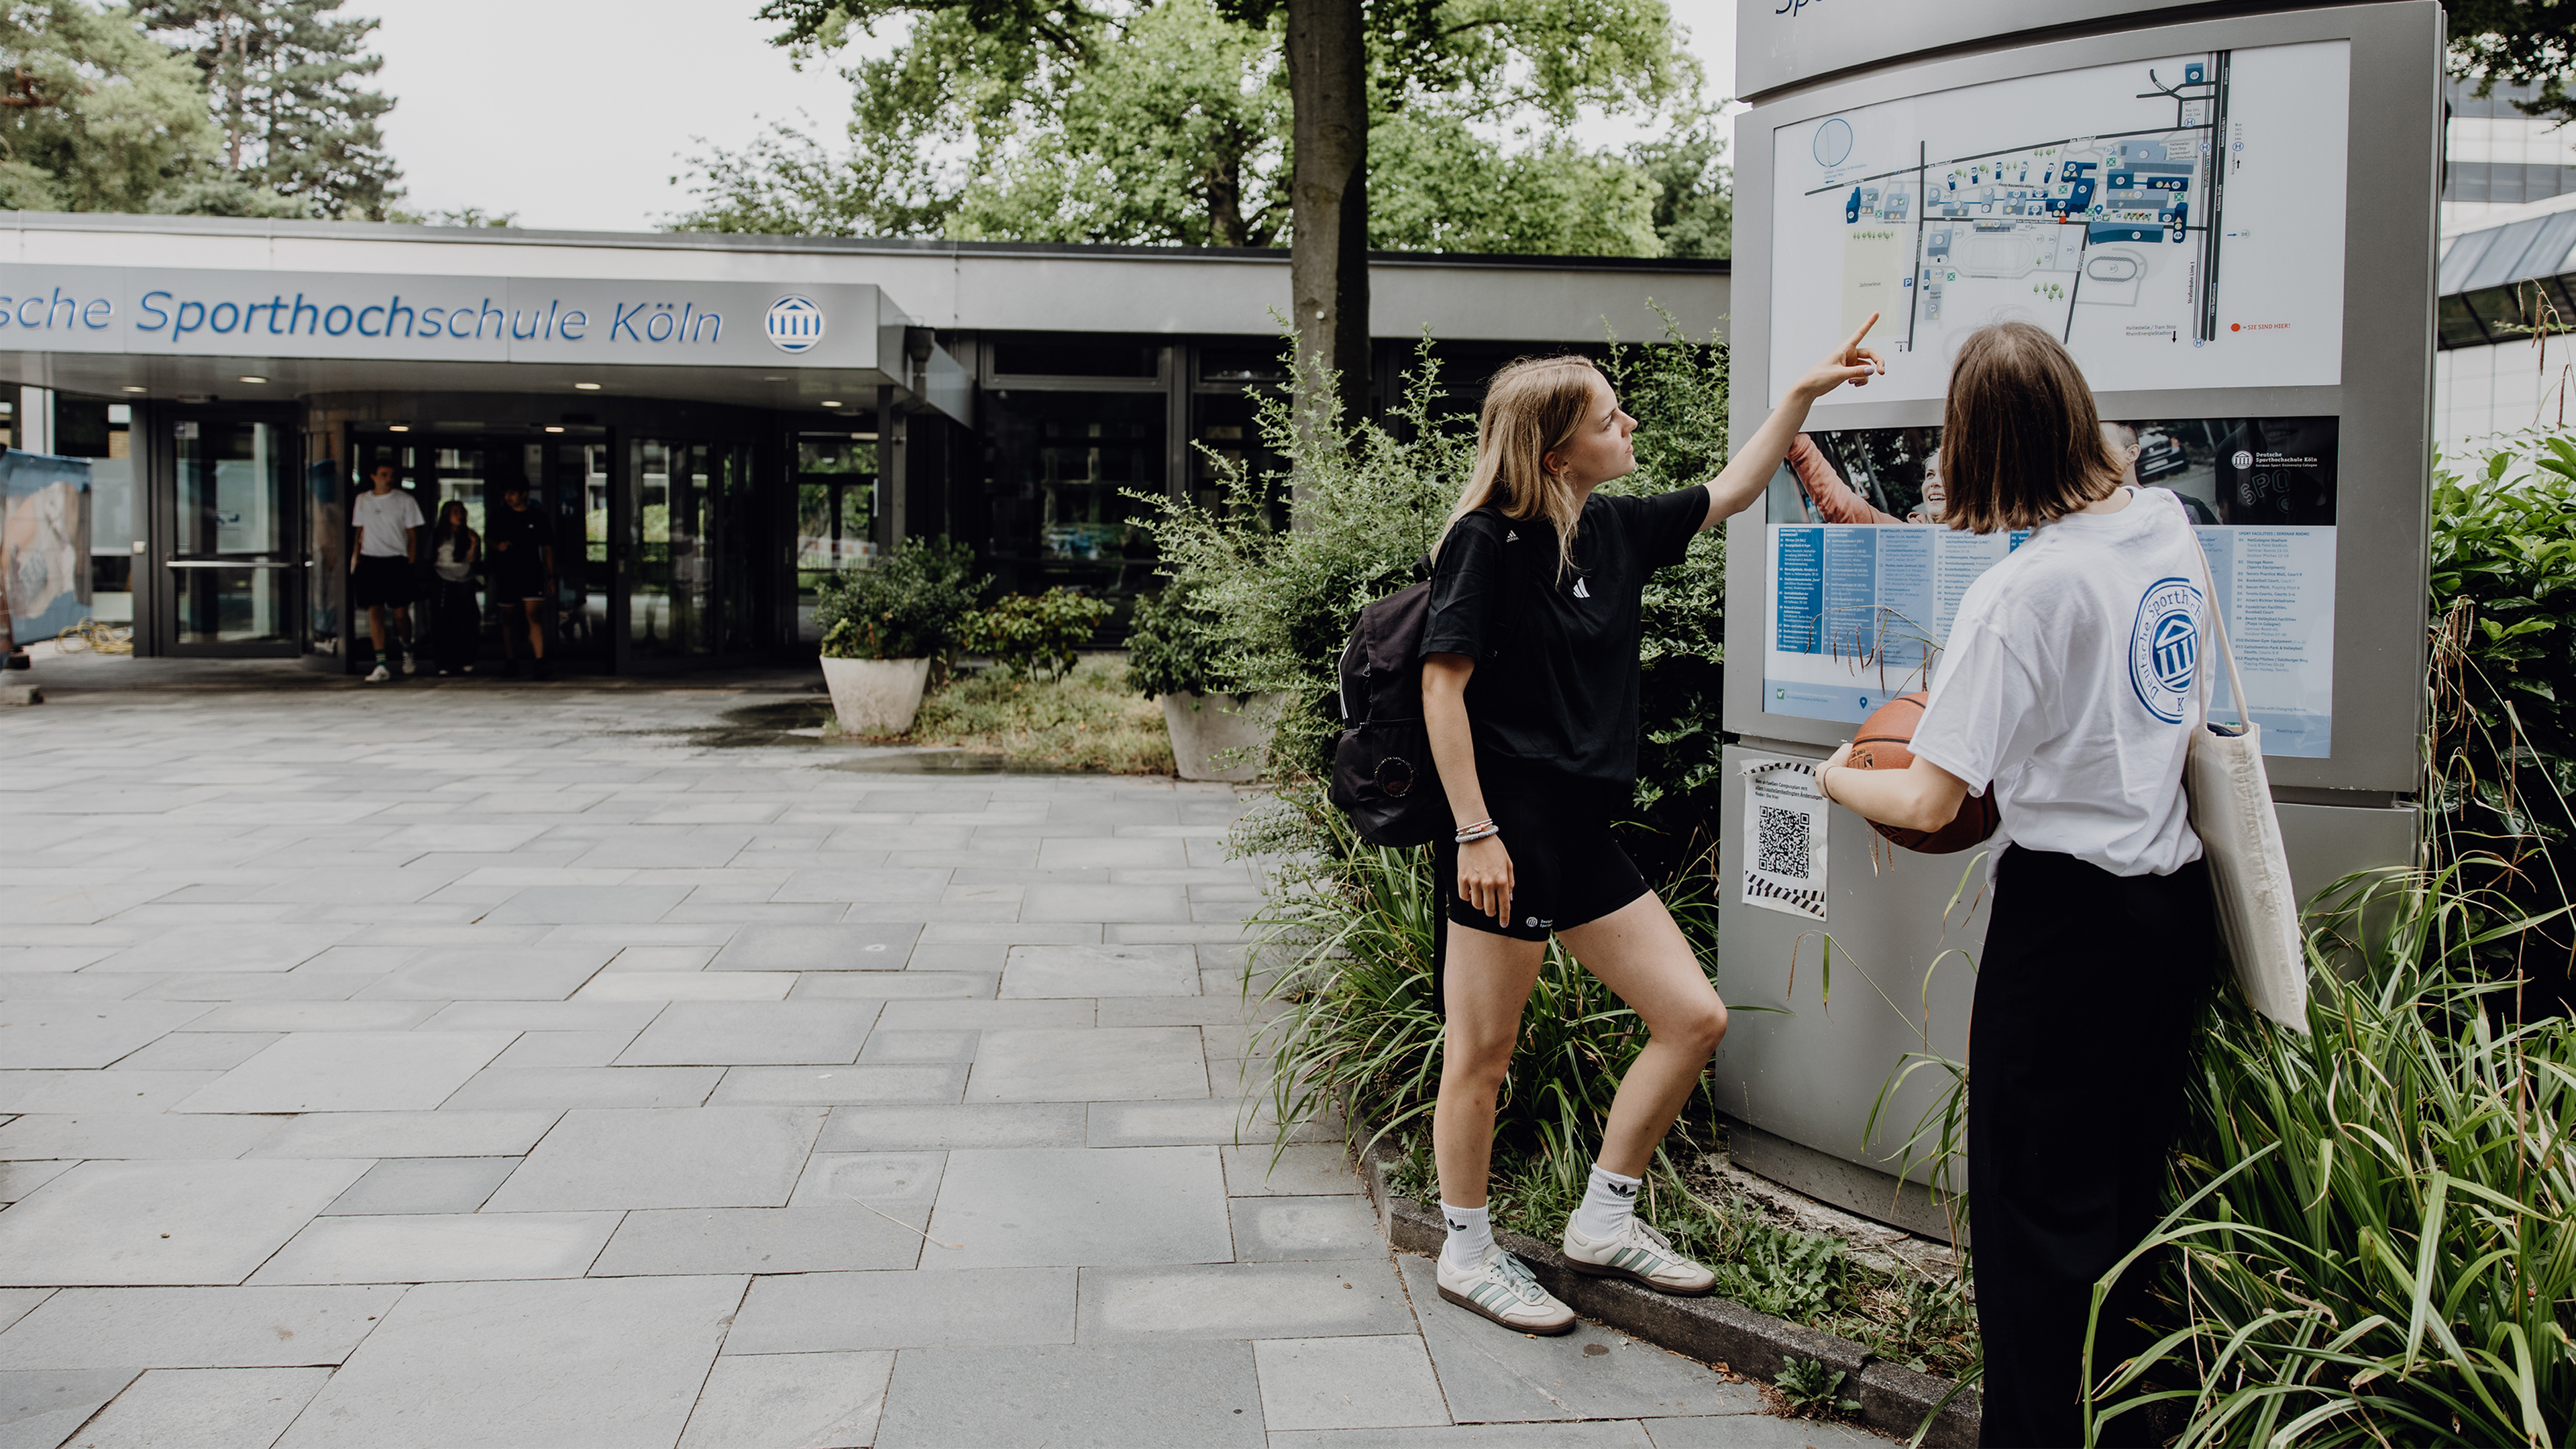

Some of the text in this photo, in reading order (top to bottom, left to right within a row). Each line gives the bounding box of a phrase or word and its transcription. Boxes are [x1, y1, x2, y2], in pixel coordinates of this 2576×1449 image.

[136, 290, 590, 342] Sporthochschule
[609, 302, 724, 343] Köln
[2139, 621, 2160, 701] Deutsche
[1800, 792, 1823, 800] Änderungen
